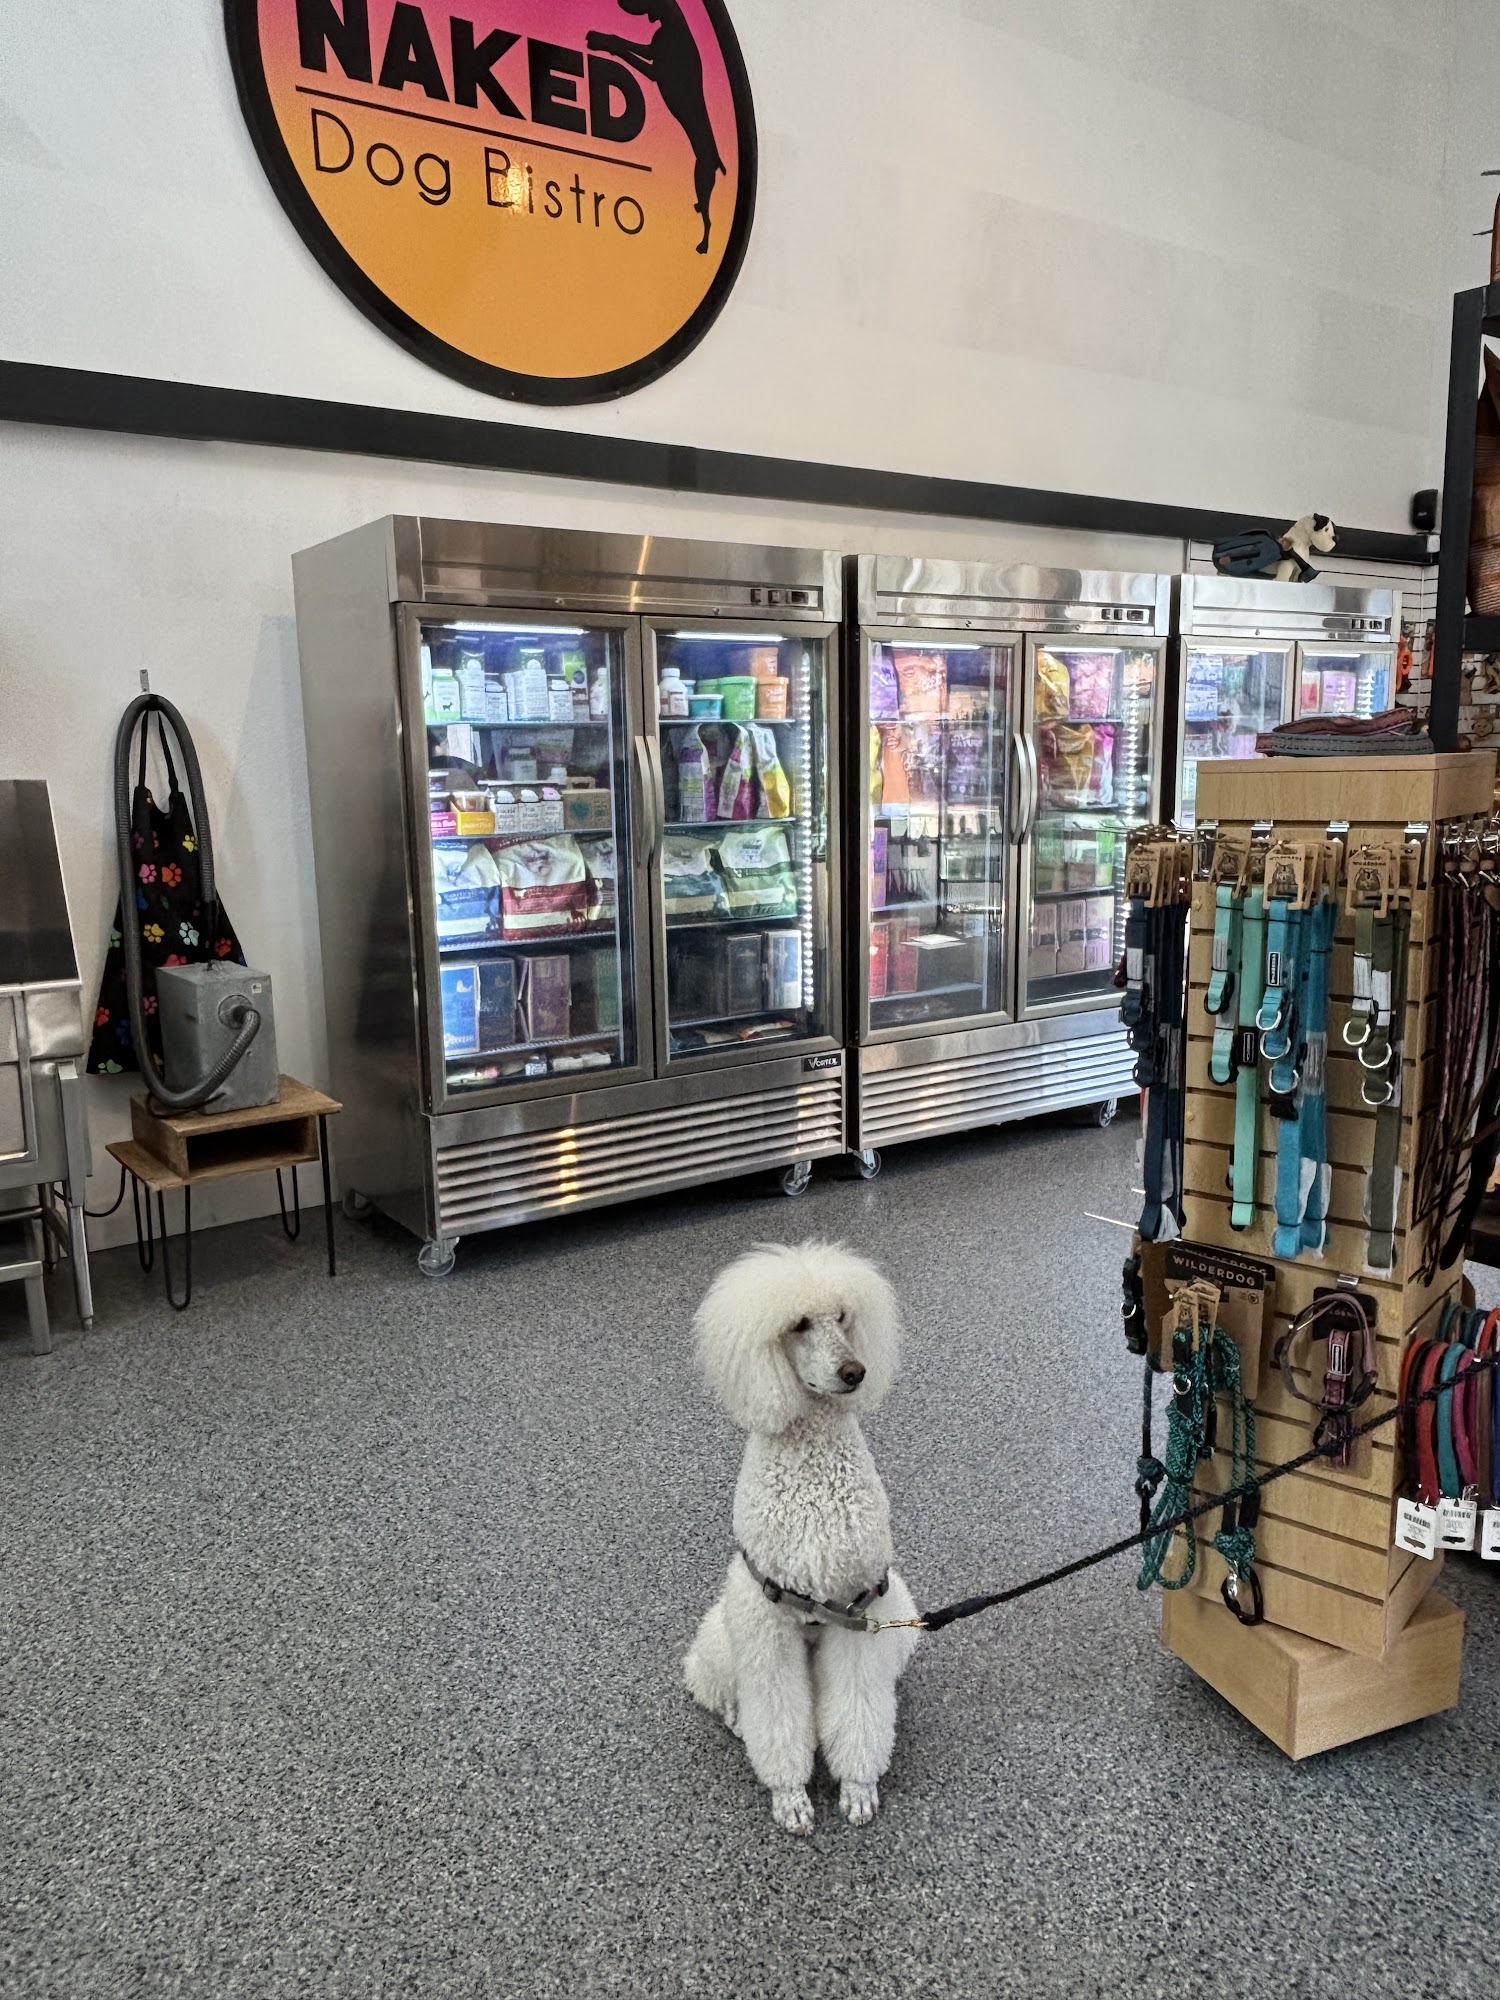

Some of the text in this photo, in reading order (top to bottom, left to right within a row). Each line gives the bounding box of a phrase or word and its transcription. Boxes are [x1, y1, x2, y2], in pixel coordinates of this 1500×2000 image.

[298, 0, 646, 143] NAKED
[310, 107, 645, 235] Dog Bistro
[1172, 1255, 1256, 1287] WILDERDOG
